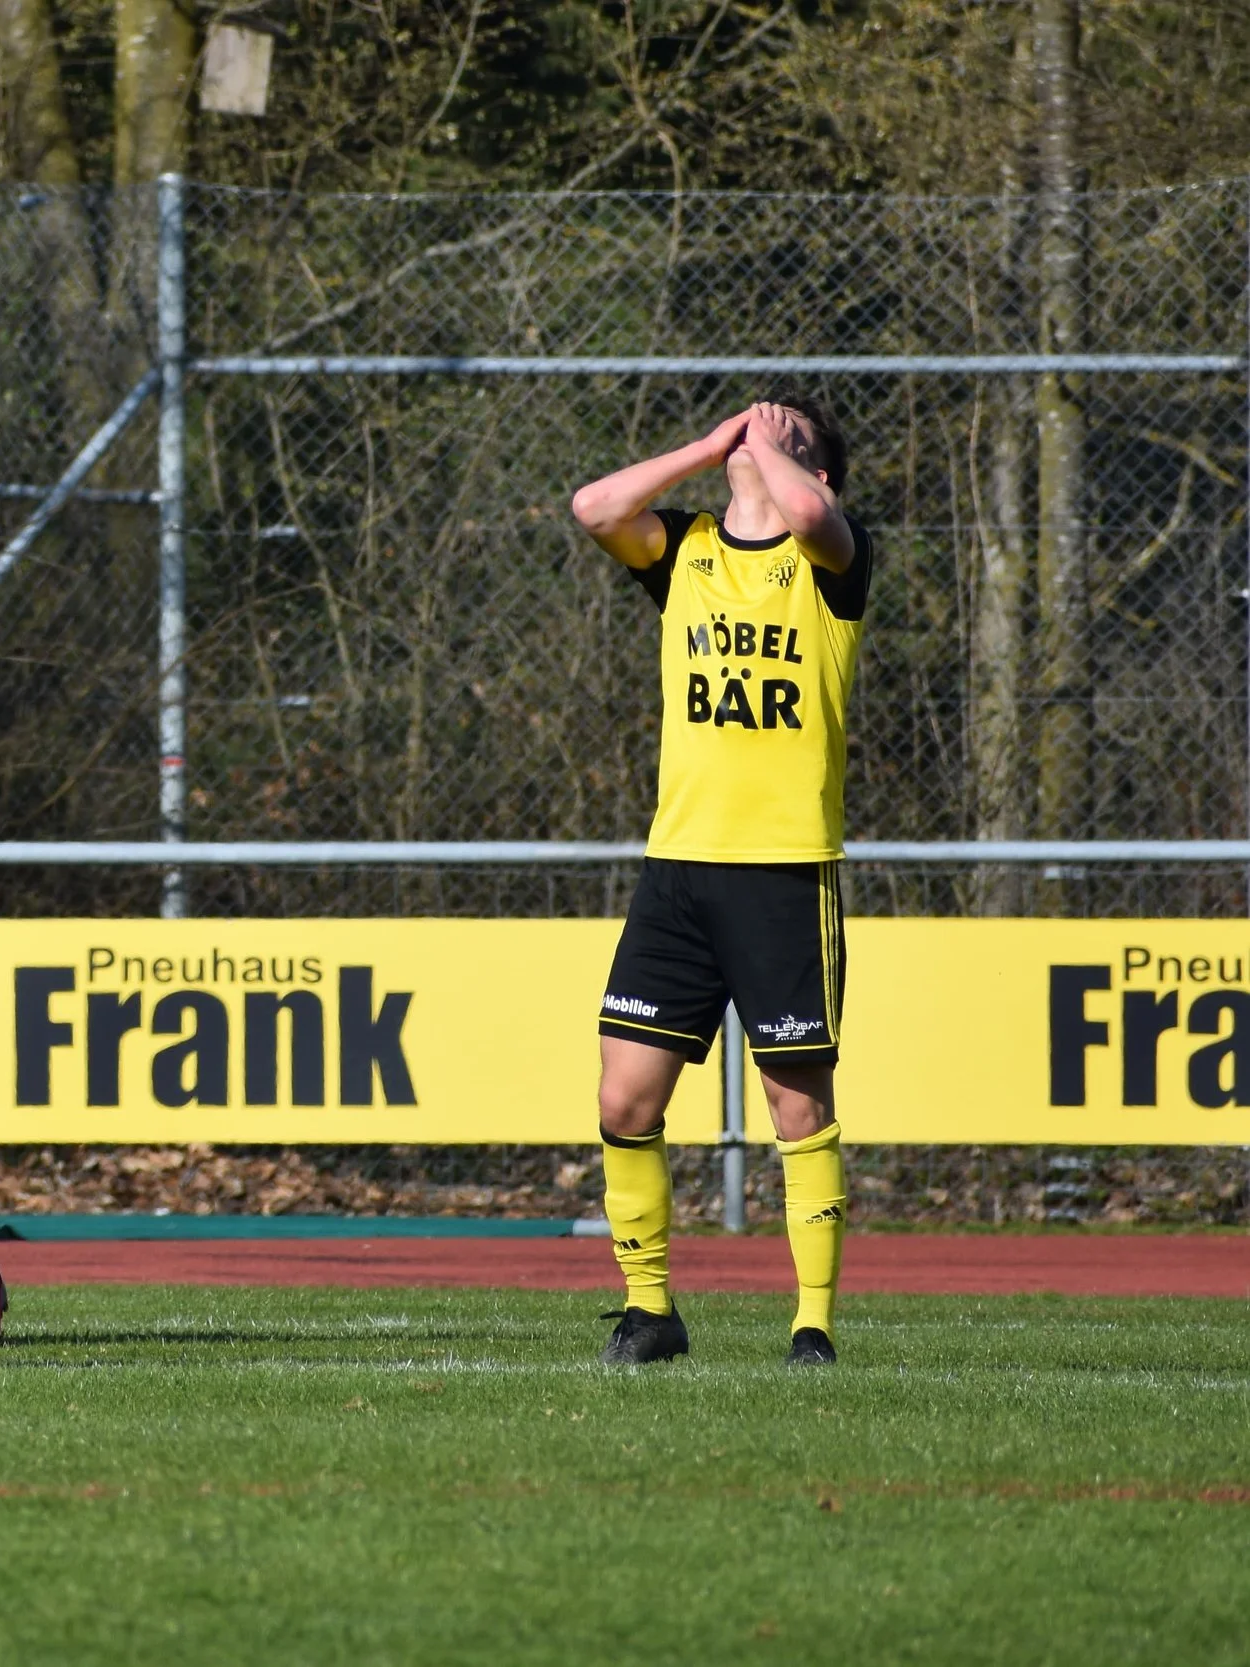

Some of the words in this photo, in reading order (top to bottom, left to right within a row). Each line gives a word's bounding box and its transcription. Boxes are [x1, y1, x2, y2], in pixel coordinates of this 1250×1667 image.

[687, 612, 803, 665] MÖBEL
[687, 666, 803, 730] BÄR
[87, 946, 323, 983] Pneuhaus
[1123, 946, 1250, 982] Pneu
[14, 965, 419, 1108] Frank
[757, 1021, 824, 1033] TELLENBAR
[1048, 964, 1250, 1109] Fra
